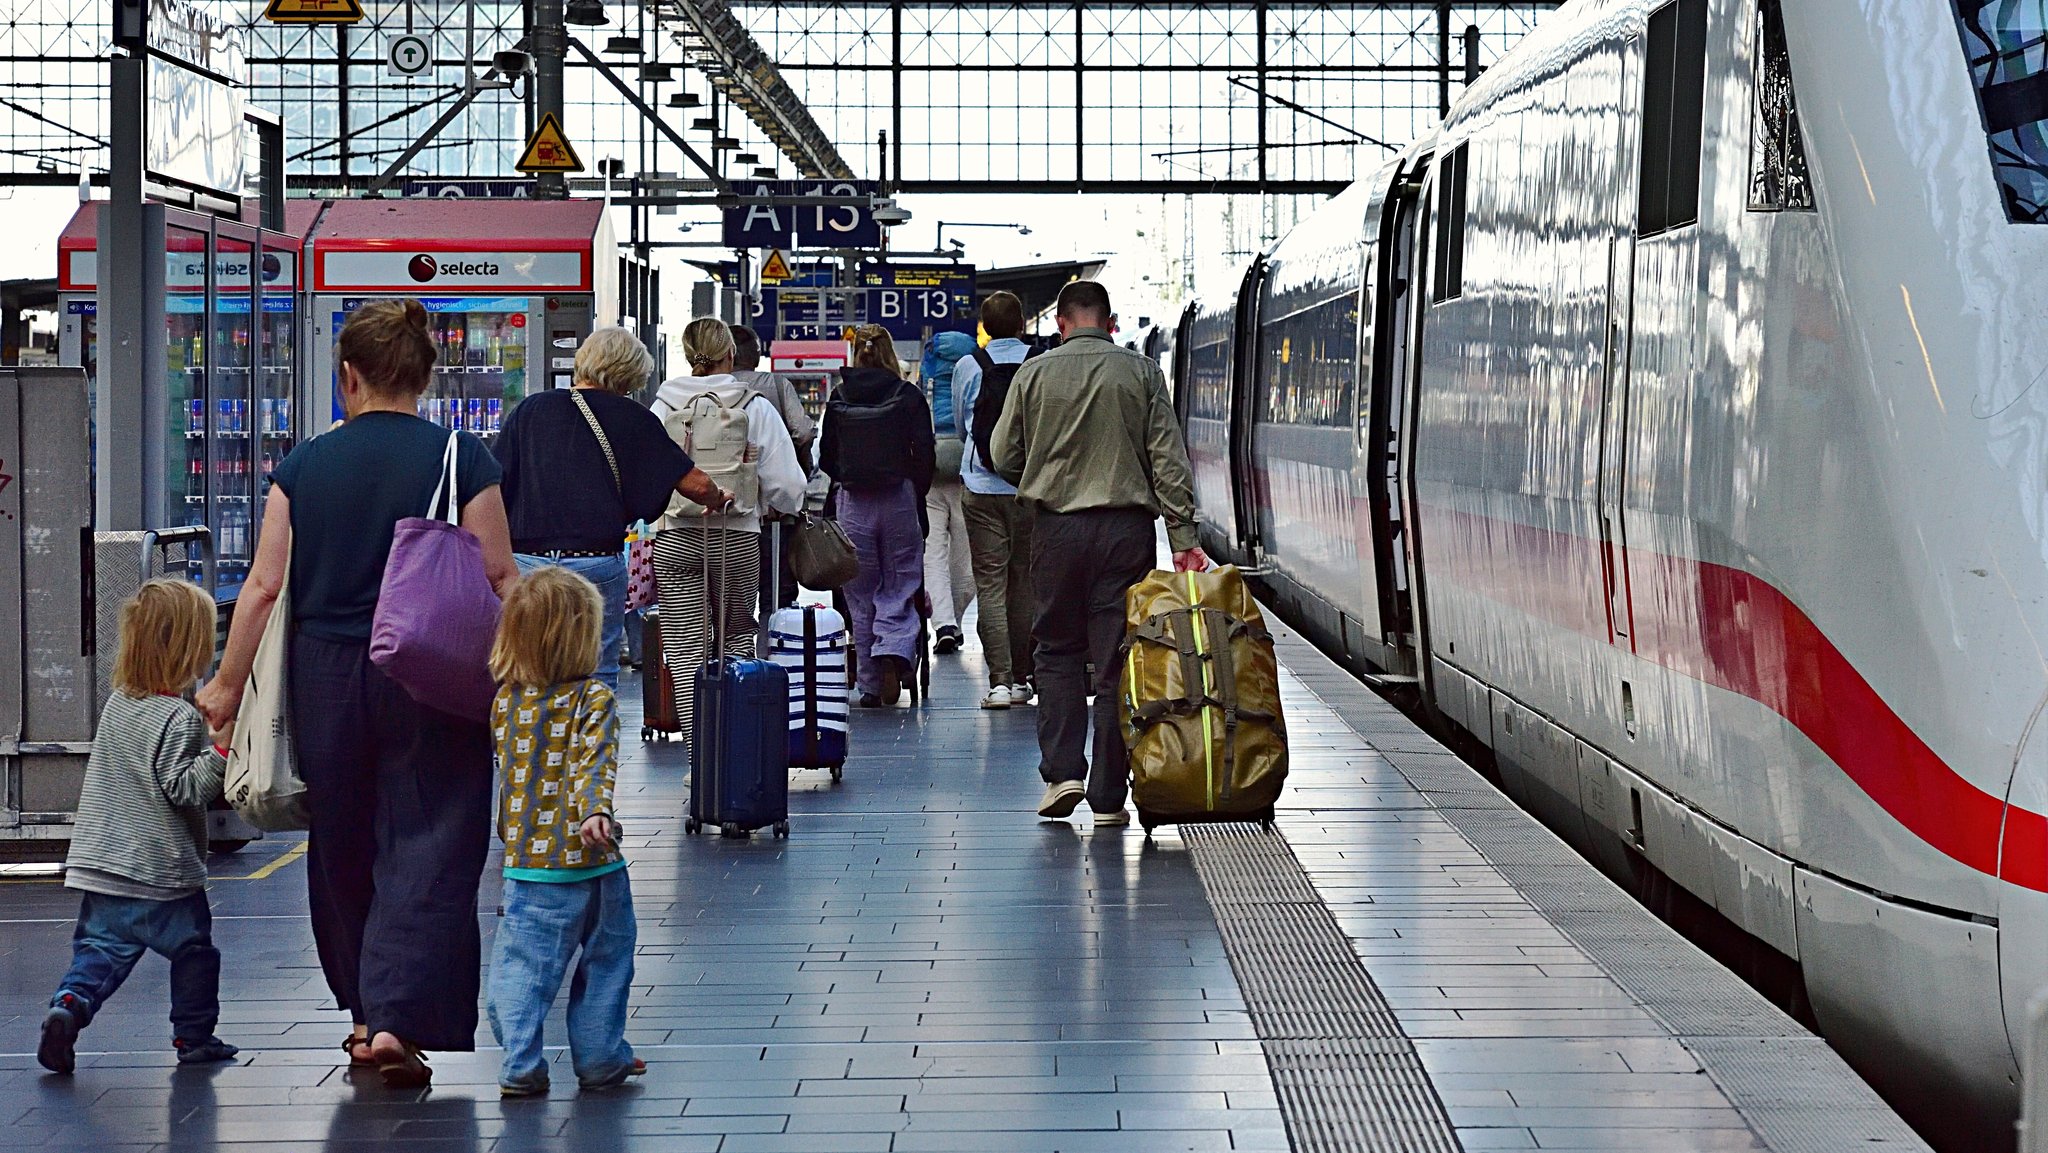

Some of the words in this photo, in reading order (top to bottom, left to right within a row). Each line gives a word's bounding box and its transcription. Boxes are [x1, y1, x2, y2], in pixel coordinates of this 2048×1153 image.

[743, 184, 781, 232] A
[805, 183, 860, 232] 13
[440, 261, 499, 276] selecta
[561, 299, 588, 309] selecta
[881, 291, 900, 318] B
[917, 290, 949, 318] 13
